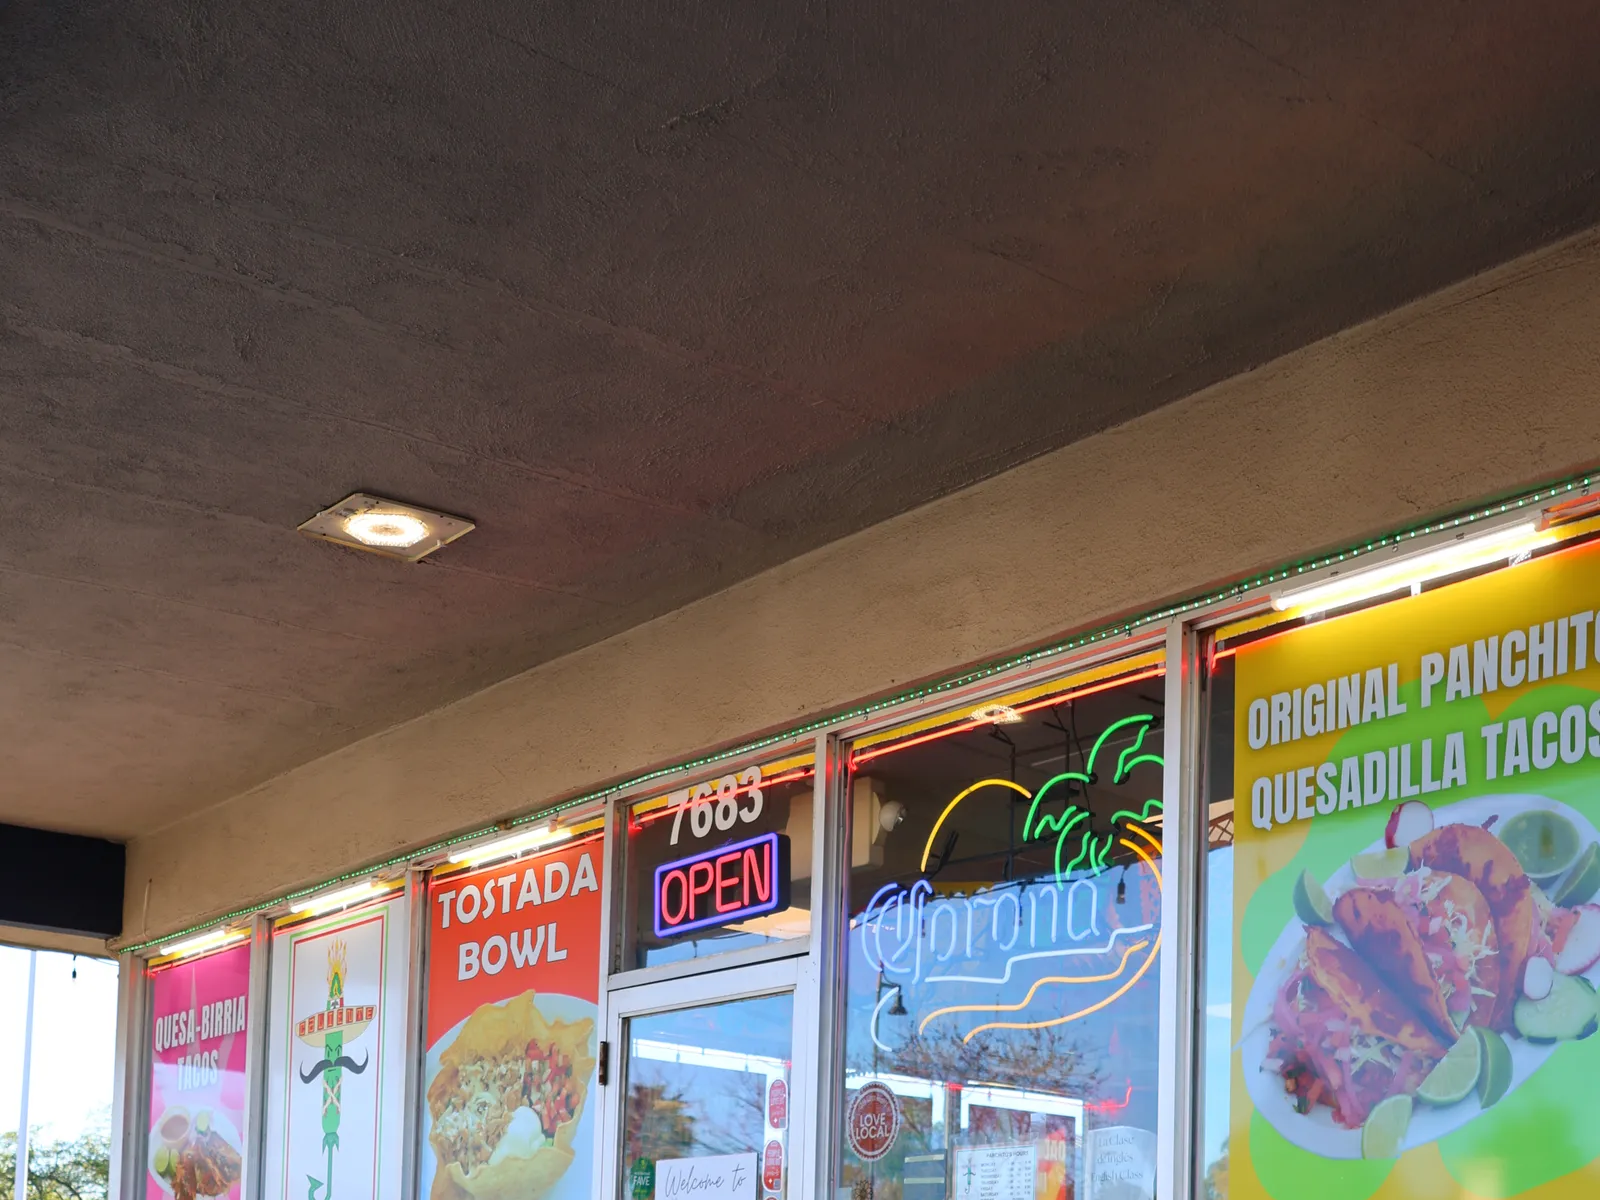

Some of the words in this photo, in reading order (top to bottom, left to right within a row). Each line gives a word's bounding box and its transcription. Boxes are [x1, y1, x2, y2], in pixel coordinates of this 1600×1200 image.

[1247, 663, 1407, 750] ORIGINAL
[1420, 609, 1600, 709] PANCHIT
[667, 765, 763, 846] 7683
[1251, 731, 1467, 831] QUESADILLA
[438, 852, 598, 929] TOSTADA
[661, 842, 771, 926] OPEN
[457, 922, 568, 981] BOWL
[862, 879, 1100, 984] Corona
[155, 995, 247, 1053] QUESA-BIRRIA
[177, 1051, 219, 1092] TACOS
[855, 1125, 890, 1140] LOCAL
[860, 1112, 886, 1127] LOVE
[633, 1175, 650, 1187] FAVE
[665, 1165, 724, 1198] Welcome
[731, 1163, 747, 1192] to
